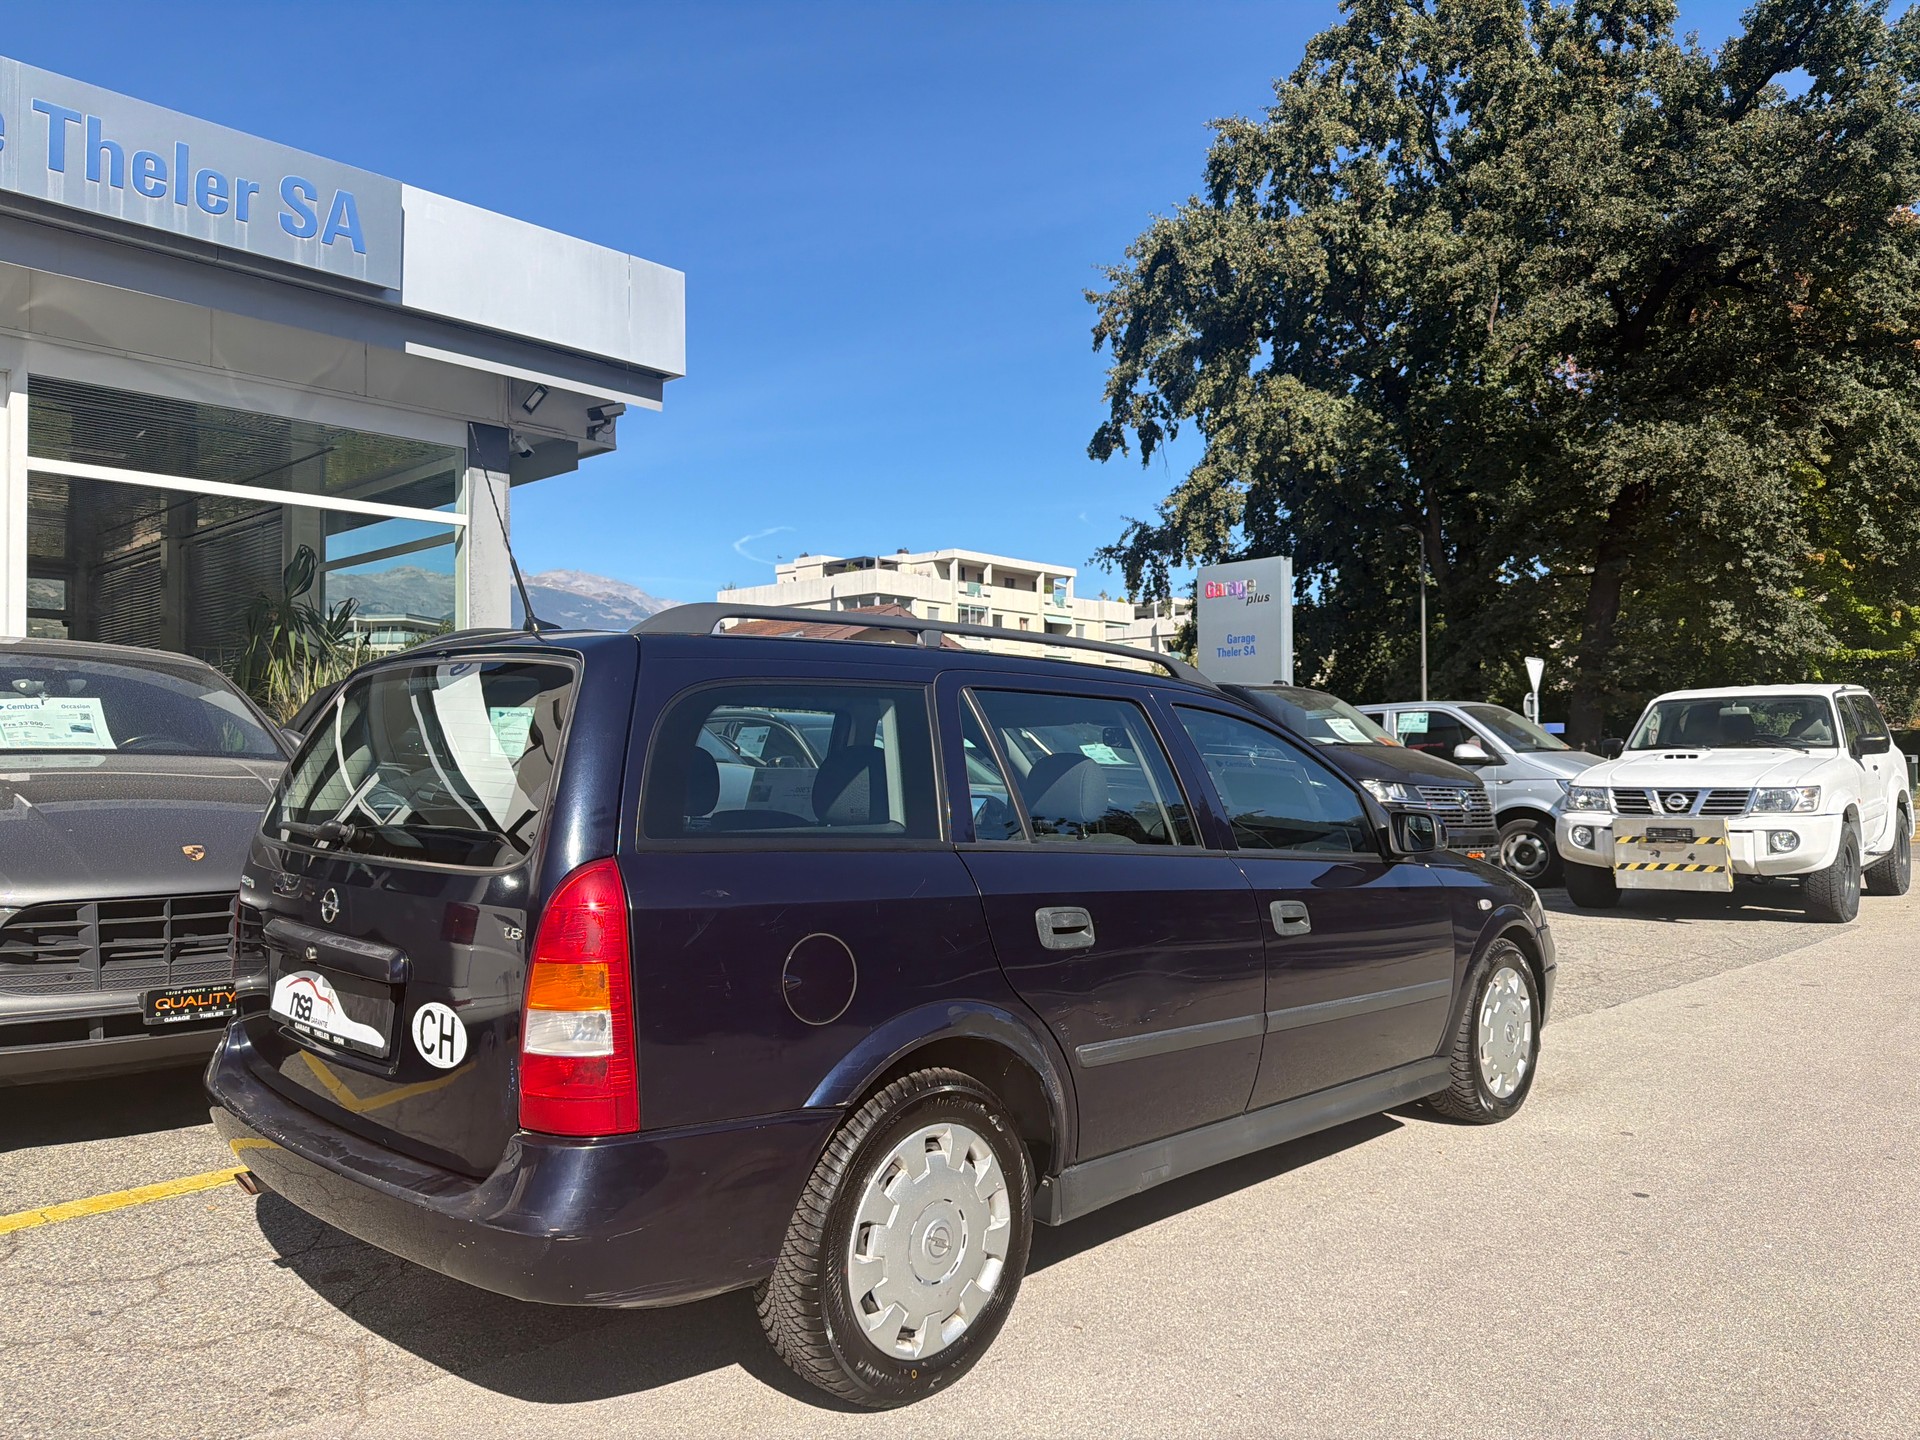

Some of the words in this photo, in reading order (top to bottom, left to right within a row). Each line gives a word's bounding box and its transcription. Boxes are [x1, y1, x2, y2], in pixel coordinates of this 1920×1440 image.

[31, 97, 260, 222] Theler
[278, 174, 367, 254] SA
[1205, 579, 1257, 600] Garage
[1246, 592, 1271, 607] plus
[1227, 633, 1256, 645] Garage
[1217, 646, 1242, 658] Theler
[1243, 645, 1256, 656] SA
[155, 991, 237, 1010] QUALITY
[289, 991, 313, 1022] nsa
[164, 1014, 191, 1023] GARAGE
[199, 1011, 224, 1019] THELER
[420, 1009, 456, 1063] CH
